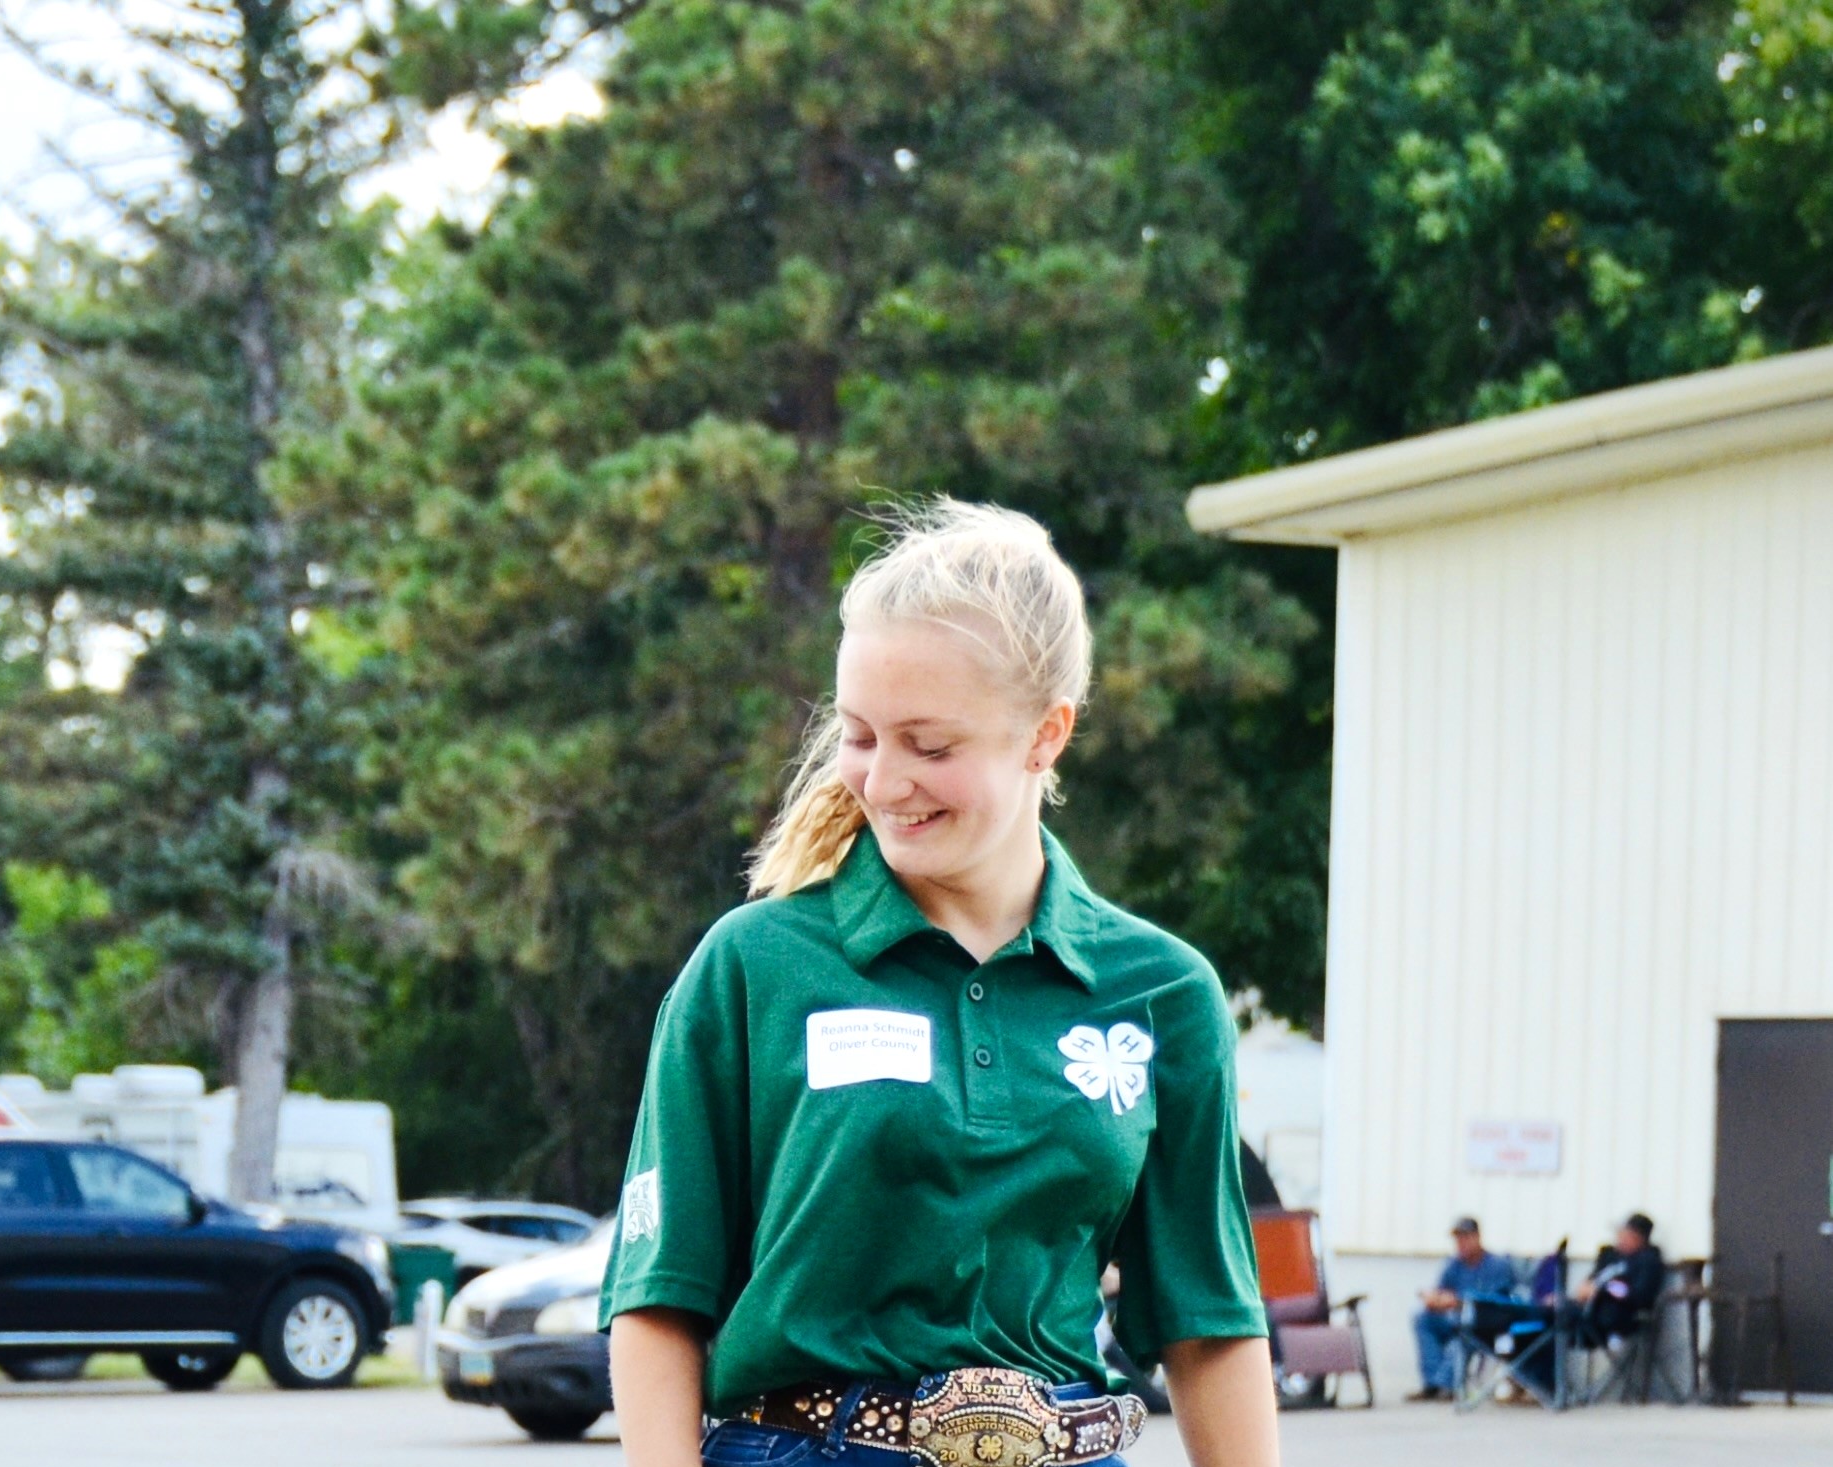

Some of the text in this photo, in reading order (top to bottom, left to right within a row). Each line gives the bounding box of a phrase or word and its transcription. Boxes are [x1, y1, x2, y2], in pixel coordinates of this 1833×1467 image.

[821, 1022, 926, 1038] Reanna Schmidt
[829, 1038, 918, 1053] Oliver County
[962, 1383, 1021, 1396] ND STATE
[937, 1414, 1040, 1439] LIVESTOCK JUDGING
[946, 1422, 1034, 1442] CHAMPION TEAM
[939, 1449, 1030, 1466] 20 21
